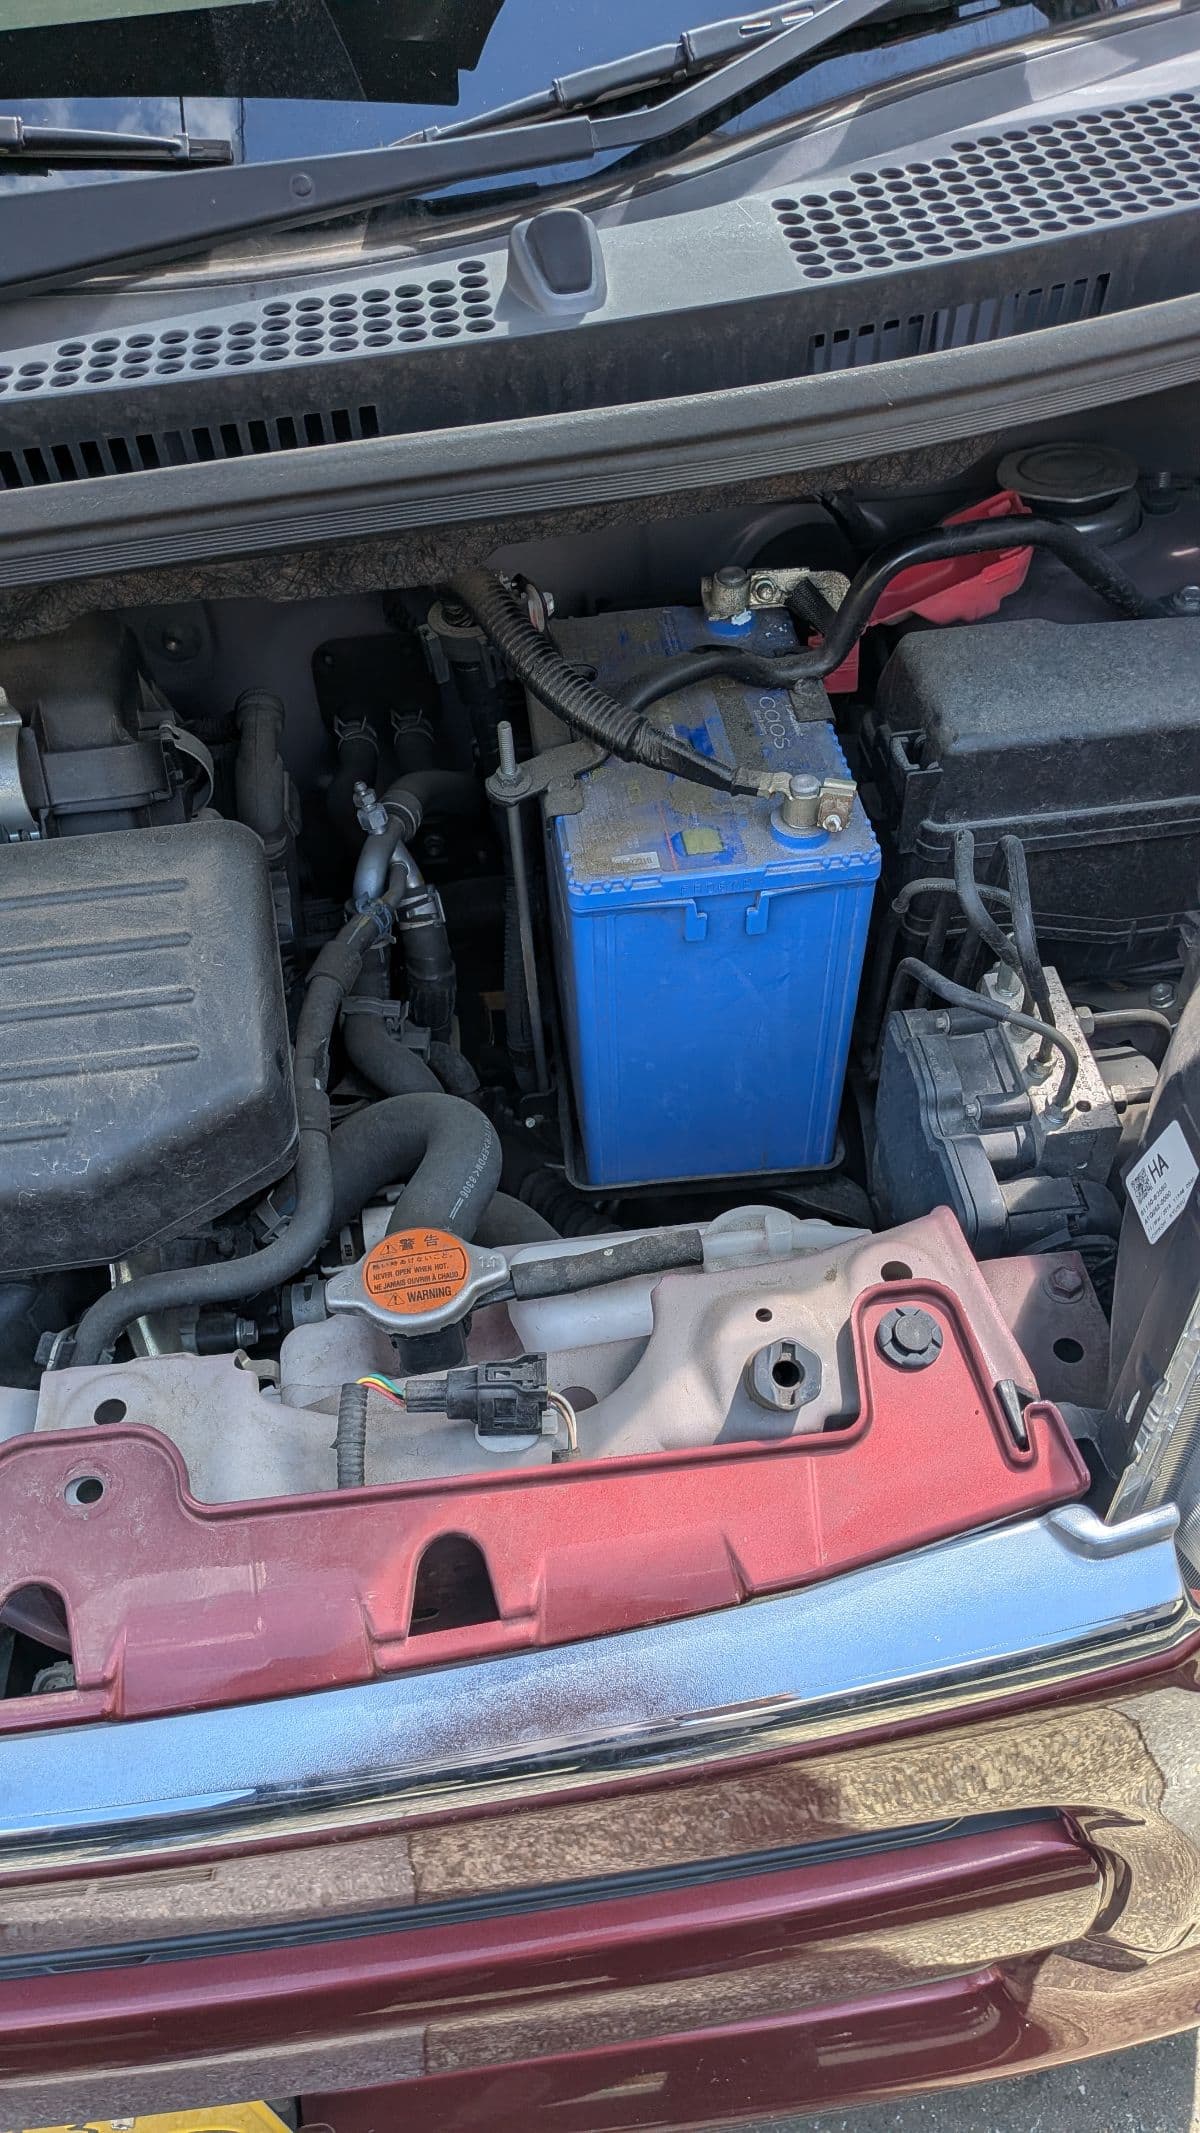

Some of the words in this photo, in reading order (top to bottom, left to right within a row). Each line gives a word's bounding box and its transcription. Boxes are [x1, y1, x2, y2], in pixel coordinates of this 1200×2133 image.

[1147, 1153, 1170, 1184] HA
[399, 1234, 440, 1251] 警告
[373, 1272, 393, 1281] NEVER
[395, 1267, 412, 1276] OPEN
[414, 1264, 433, 1274] WHEN
[434, 1263, 449, 1271] HOT.
[373, 1283, 382, 1291] NE
[383, 1279, 406, 1290] JAMAIS
[407, 1276, 431, 1286] OUVRIR
[406, 1286, 452, 1302] WARNING
